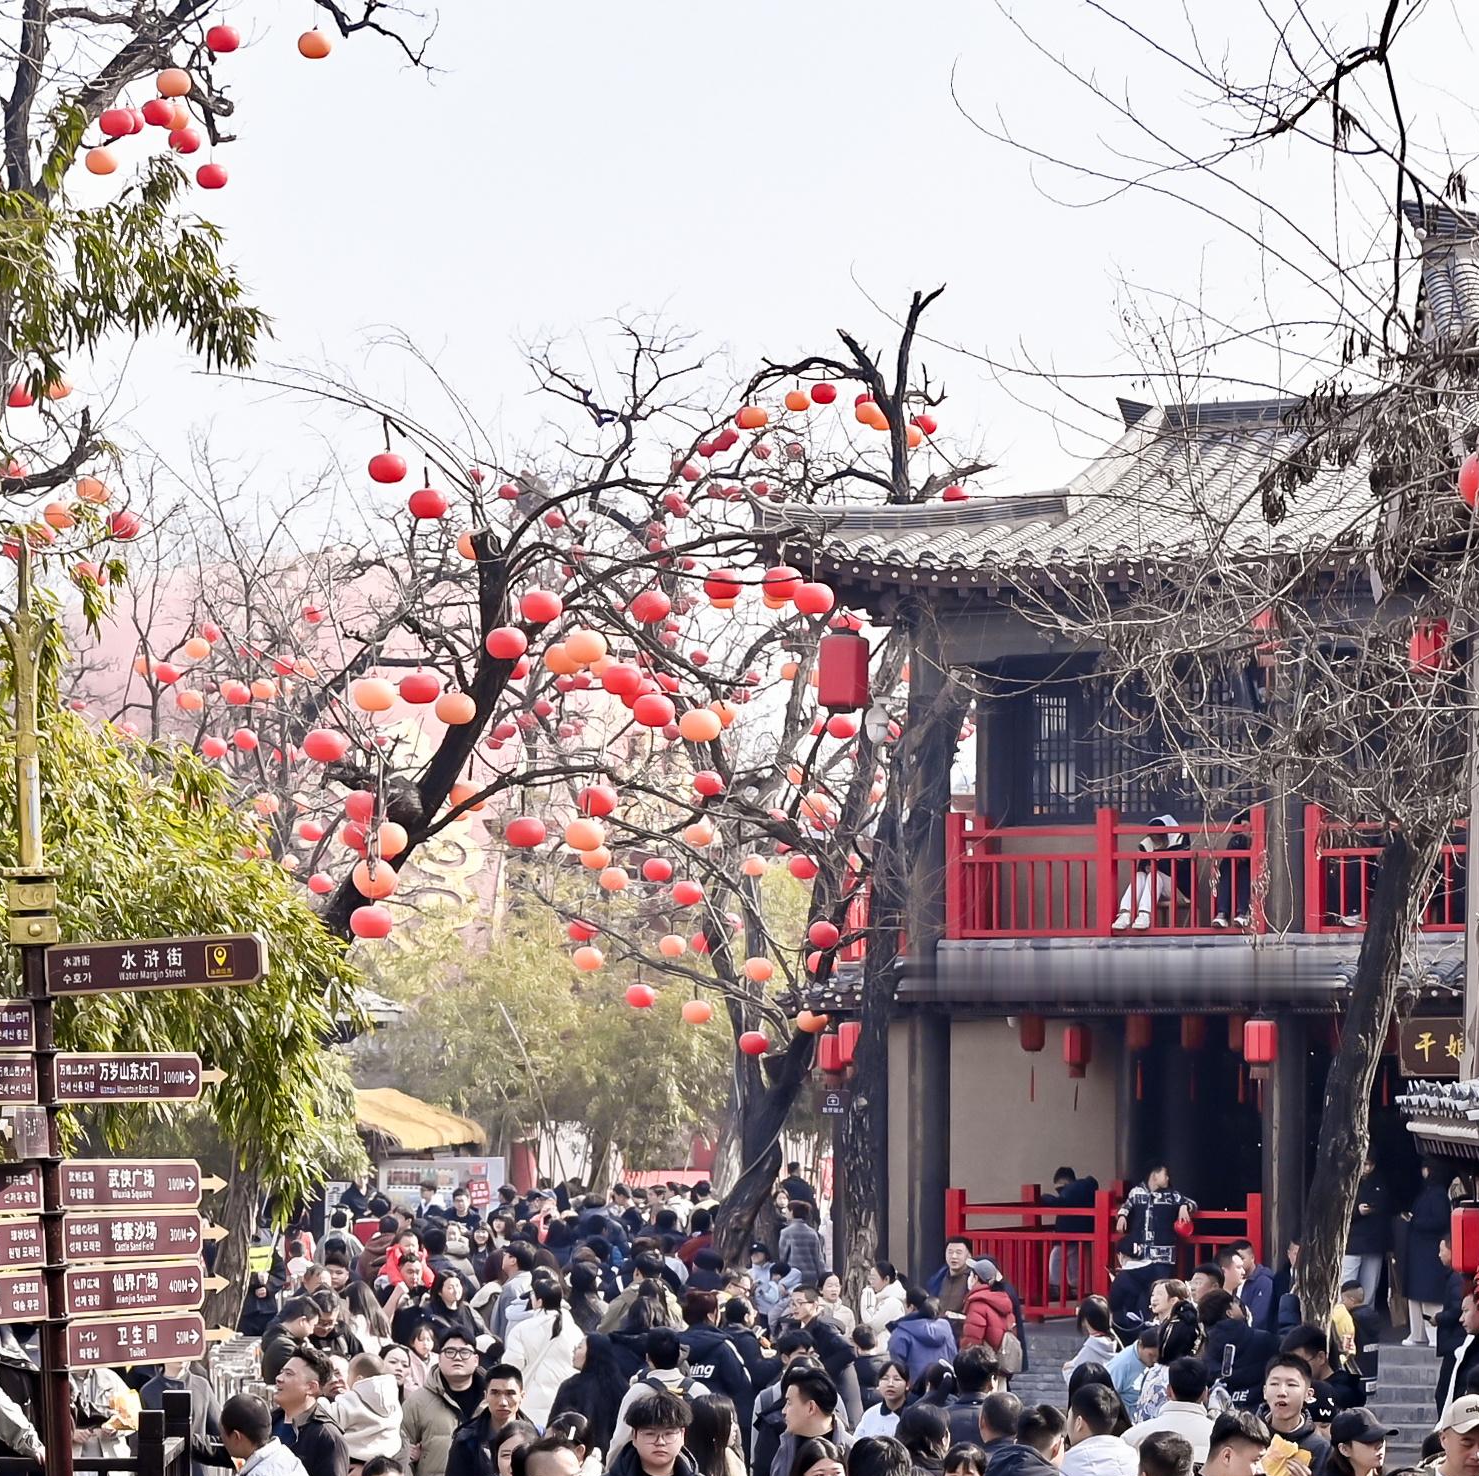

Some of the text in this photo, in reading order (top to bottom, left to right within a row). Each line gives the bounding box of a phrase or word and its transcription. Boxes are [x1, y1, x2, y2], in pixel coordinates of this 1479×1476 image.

[121, 947, 183, 970] 水浒街
[62, 971, 92, 985] 수호가
[119, 967, 187, 983] Water Margin Street
[99, 1062, 160, 1081] 万岁山东大门
[163, 1071, 185, 1084] 1000M
[107, 1169, 155, 1188] 武侠广场
[168, 1177, 185, 1191] 100M
[131, 1189, 153, 1201] Square
[110, 1221, 158, 1241] 城寨沙场
[170, 1228, 187, 1242] 300M
[112, 1272, 159, 1292] 仙界广场
[169, 1279, 188, 1294] 400M
[136, 1293, 157, 1305] Square
[79, 1331, 98, 1343] トイレ
[116, 1324, 158, 1346] 卫生间
[175, 1330, 189, 1345] 50M
[129, 1347, 147, 1358] Toilet
